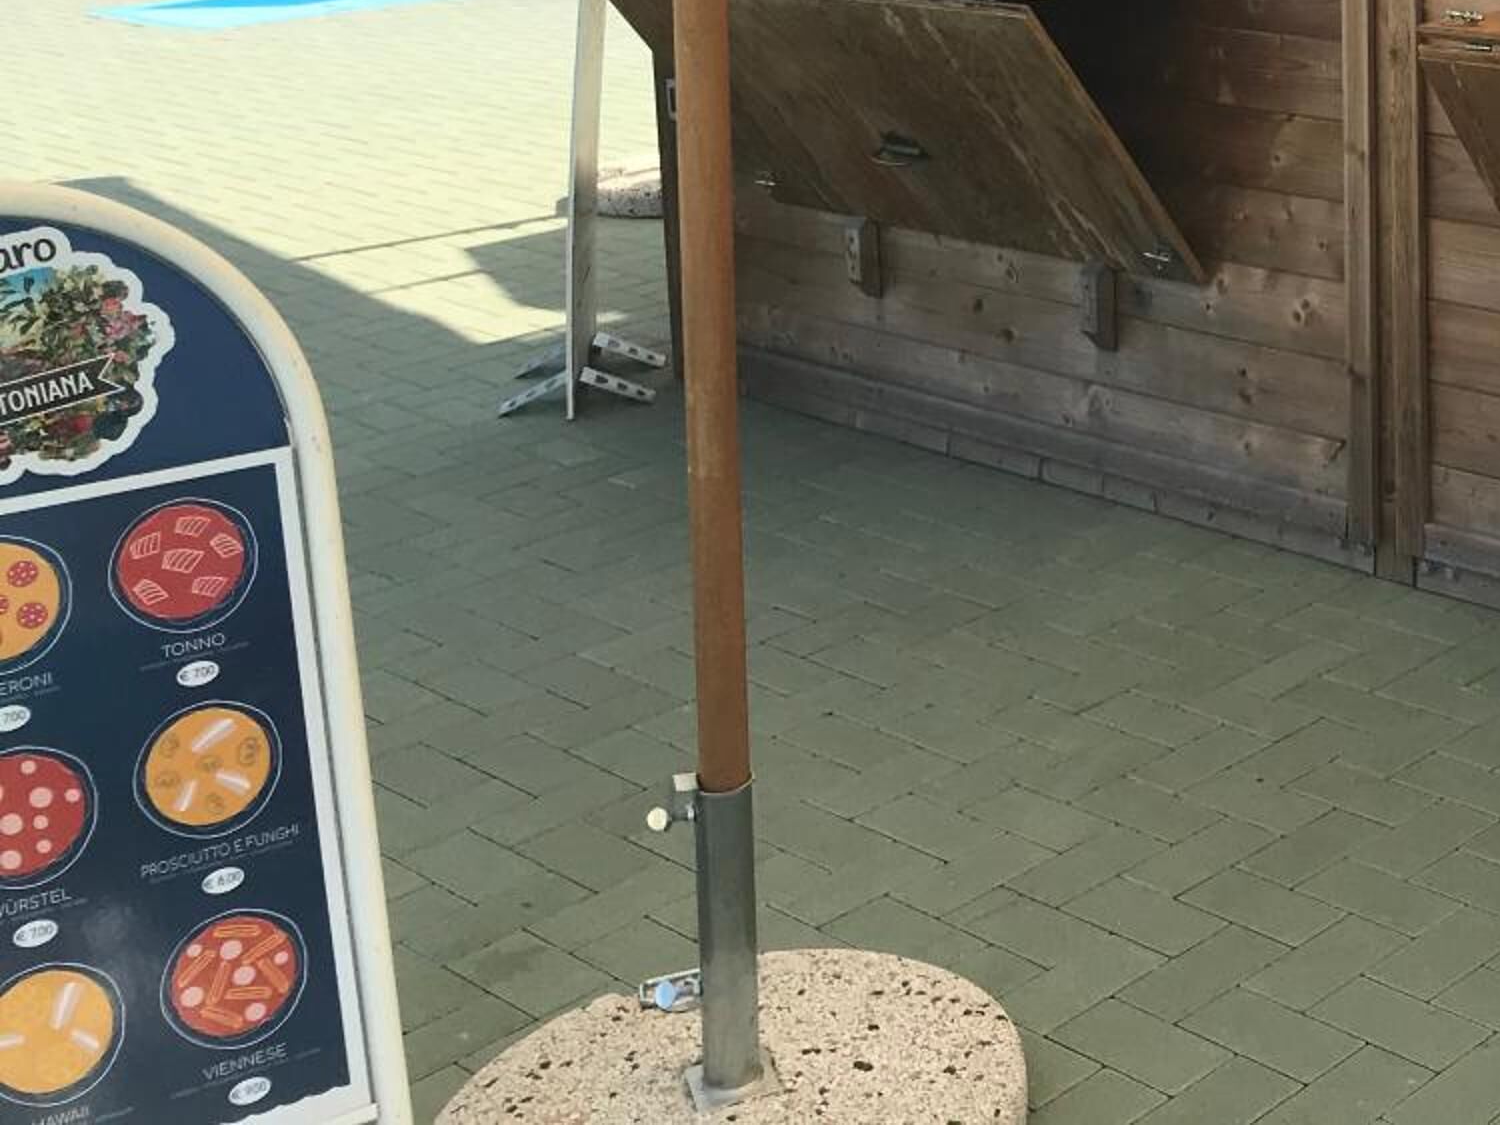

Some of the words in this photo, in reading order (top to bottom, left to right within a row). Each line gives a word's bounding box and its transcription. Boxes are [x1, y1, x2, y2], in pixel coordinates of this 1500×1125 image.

[161, 633, 226, 659] TONNO
[140, 842, 230, 879] PROSCIUTTO
[235, 839, 244, 853] E
[245, 823, 300, 848] FUNGHI
[202, 1043, 289, 1081] VIENNESE
